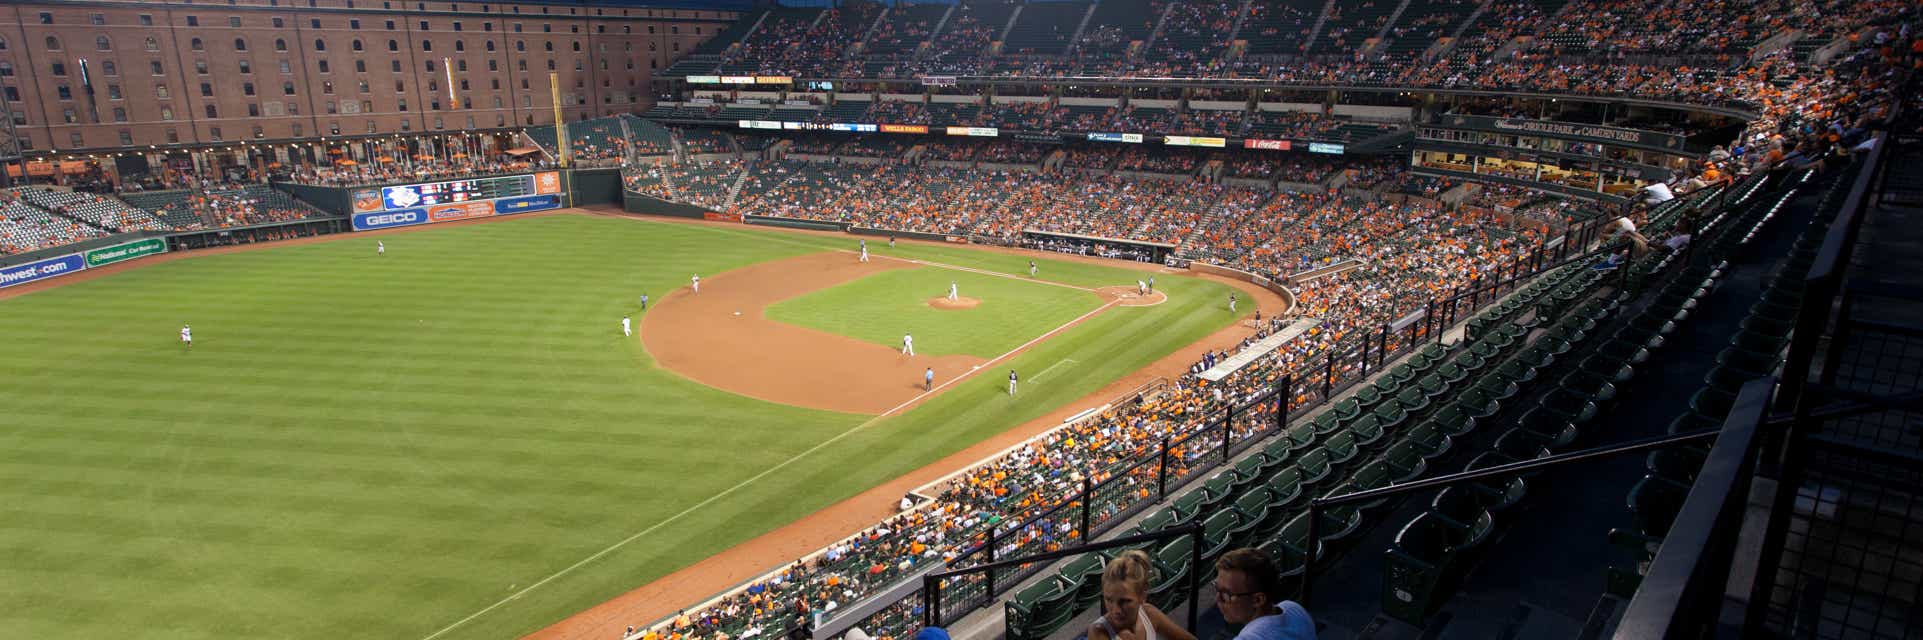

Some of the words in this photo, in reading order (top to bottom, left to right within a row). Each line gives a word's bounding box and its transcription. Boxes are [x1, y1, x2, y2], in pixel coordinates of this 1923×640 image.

[1524, 122, 1554, 132] ORIOLE
[1554, 123, 1574, 134] PARK
[1582, 126, 1616, 138] CAMDEN
[1616, 130, 1640, 142] YARDS
[366, 212, 417, 226] GEICO
[0, 262, 67, 283] hwest.com
